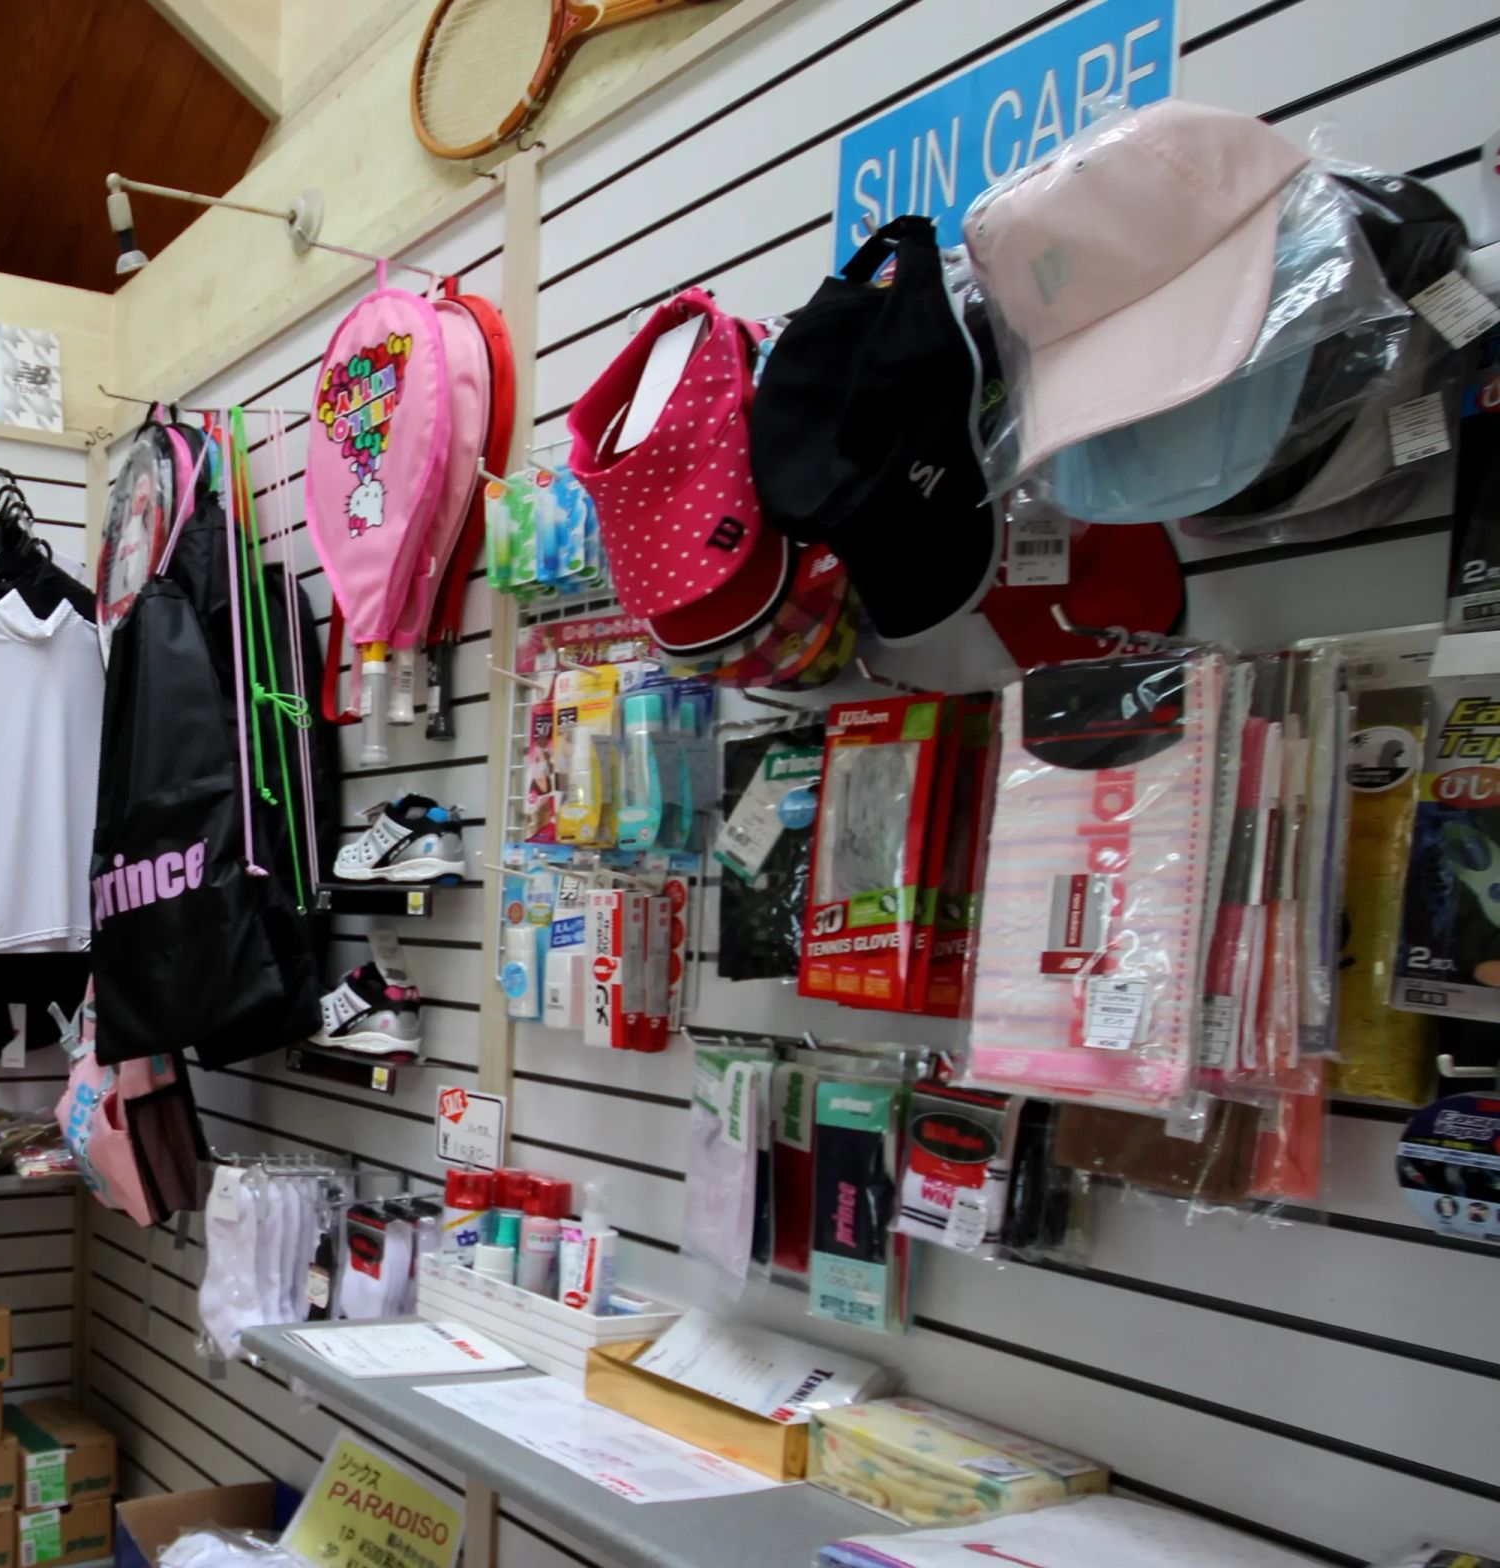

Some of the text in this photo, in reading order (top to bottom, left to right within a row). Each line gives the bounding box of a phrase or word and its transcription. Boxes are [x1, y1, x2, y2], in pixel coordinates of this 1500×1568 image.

[851, 116, 961, 247] SUN
[334, 363, 397, 417] KITTY
[332, 391, 396, 442] HELLO
[838, 709, 890, 727] Wilson
[770, 754, 823, 779] princ
[807, 932, 901, 958] TENNIS GLOVE
[811, 906, 844, 937] 3D
[832, 1181, 858, 1249] prince
[327, 1481, 450, 1546] PARADISO
